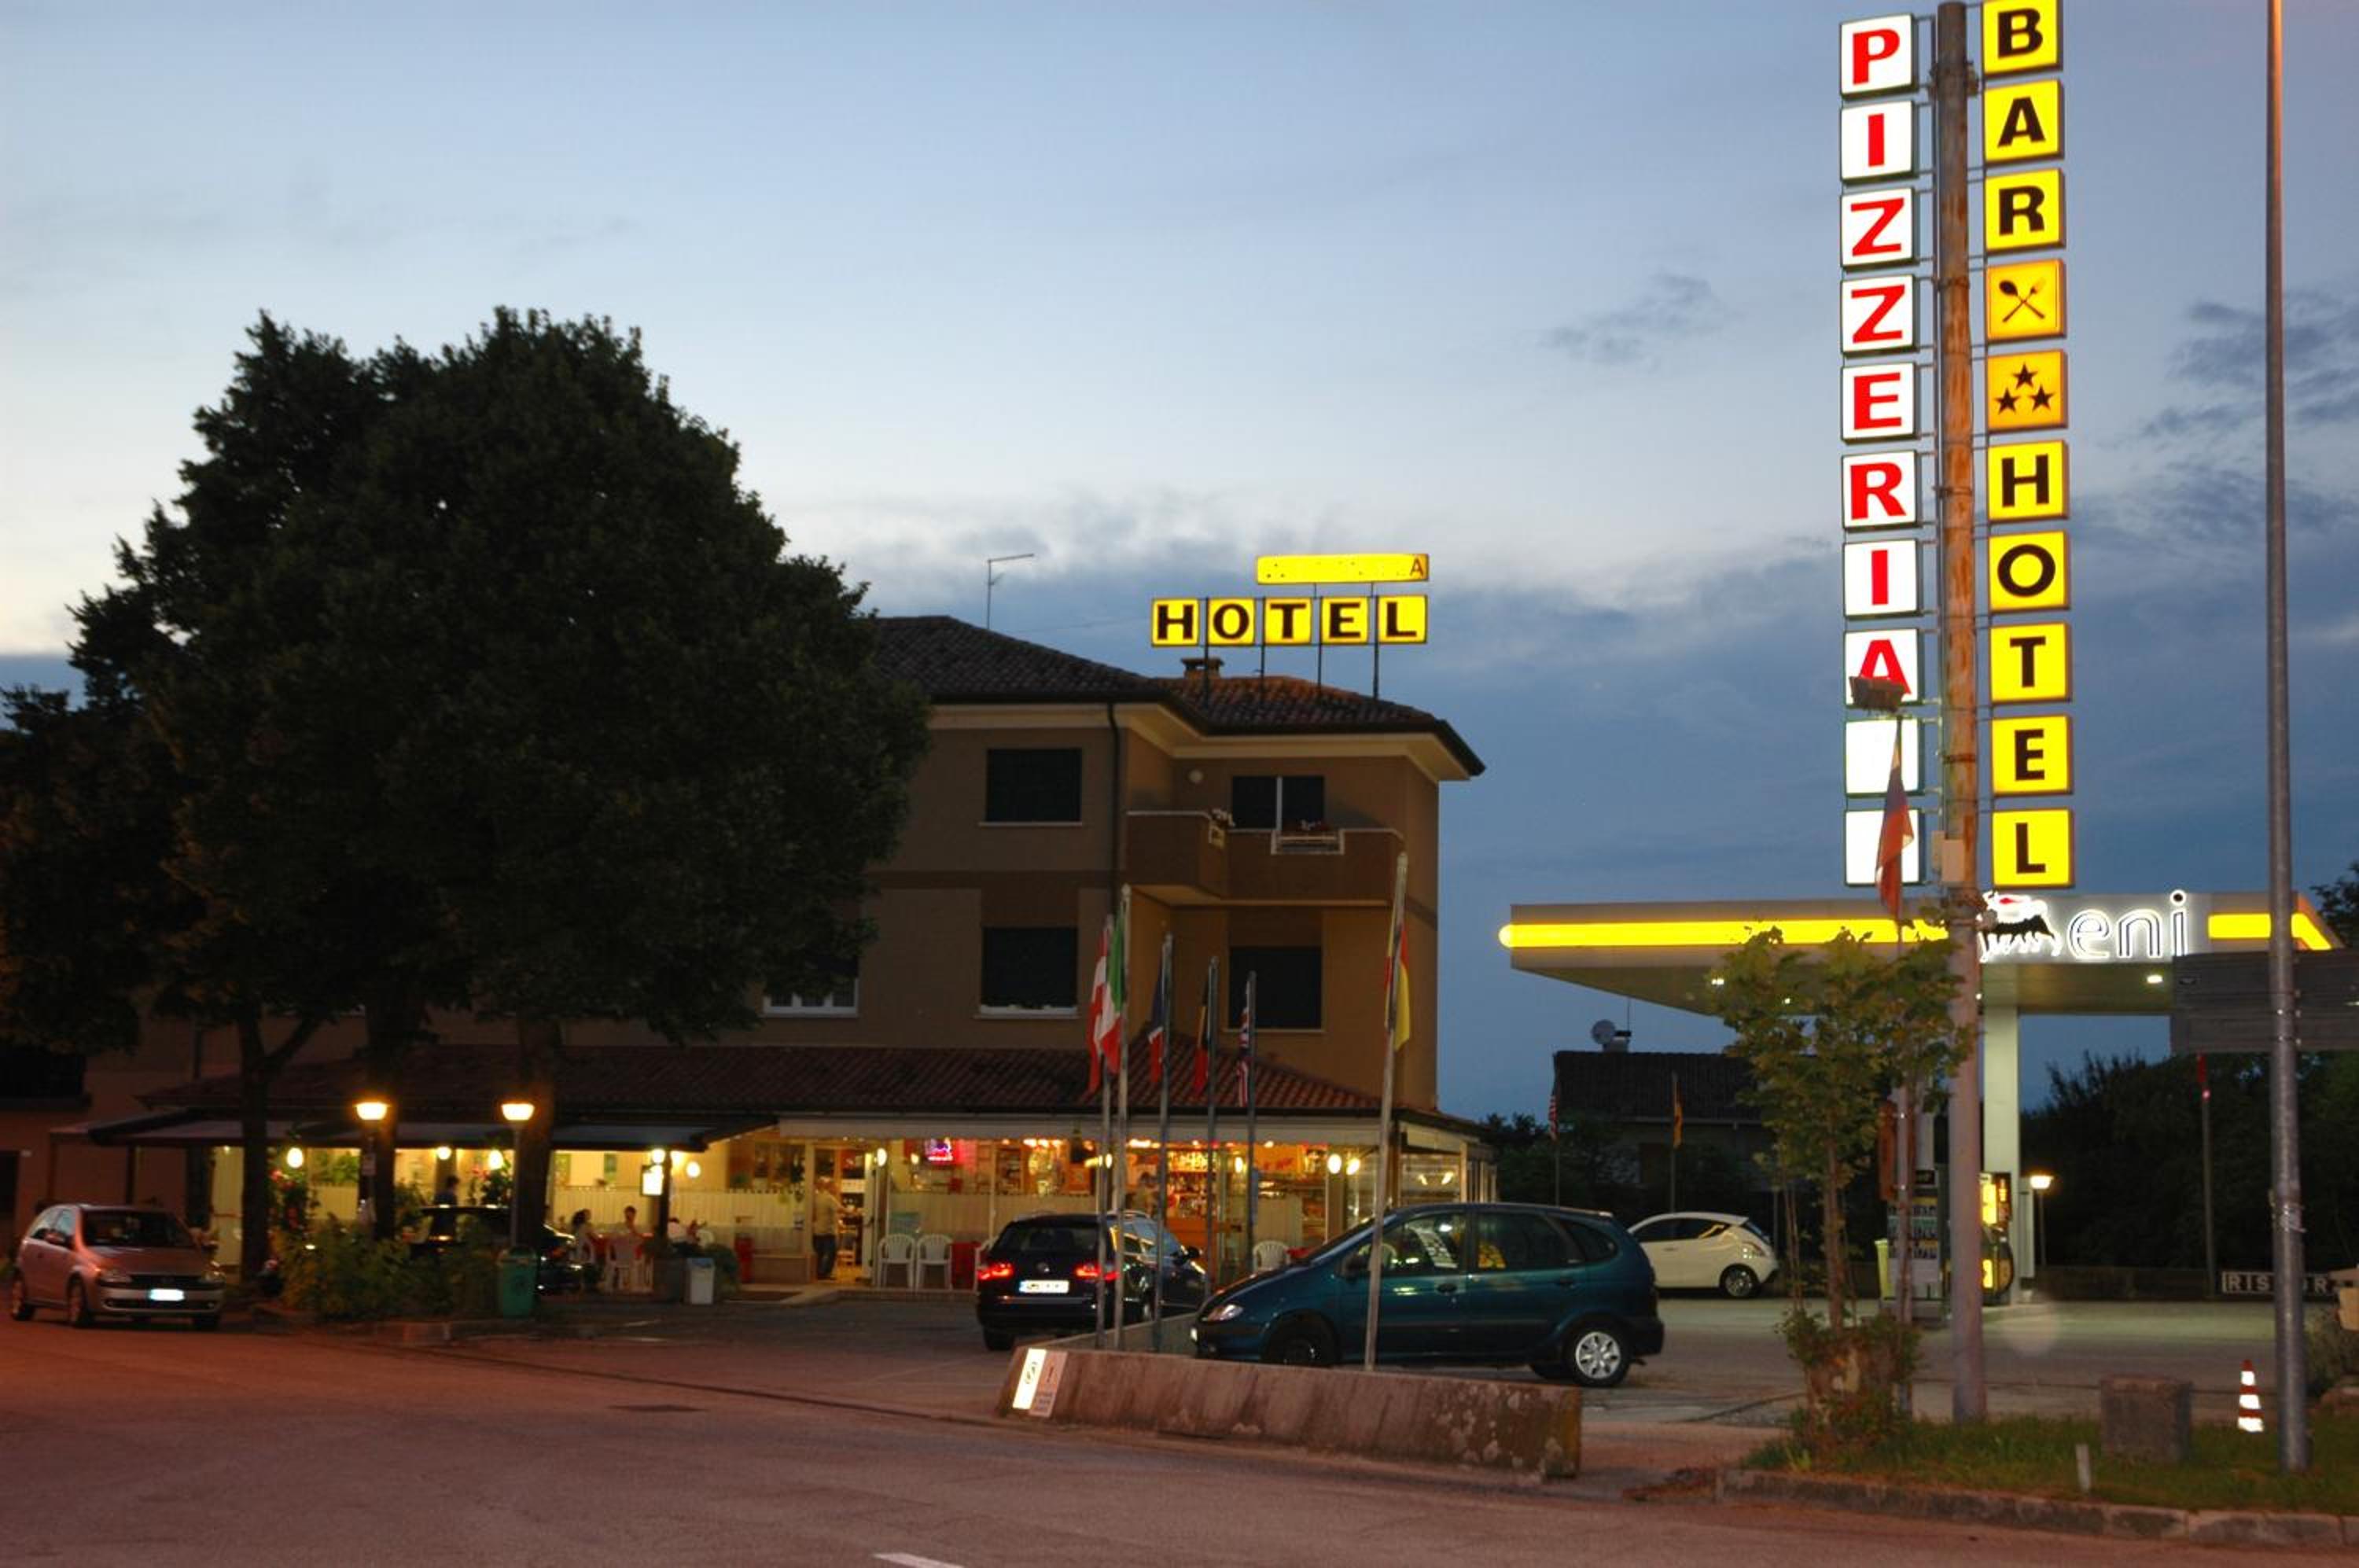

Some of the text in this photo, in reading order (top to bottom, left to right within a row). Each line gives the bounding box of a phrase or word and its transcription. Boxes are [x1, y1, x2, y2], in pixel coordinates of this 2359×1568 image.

[1850, 28, 1912, 695] PIZZERIA
[1997, 8, 2055, 874] BAR HOTEL
[1157, 602, 1418, 639] HOTEL
[2067, 889, 2189, 959] eni
